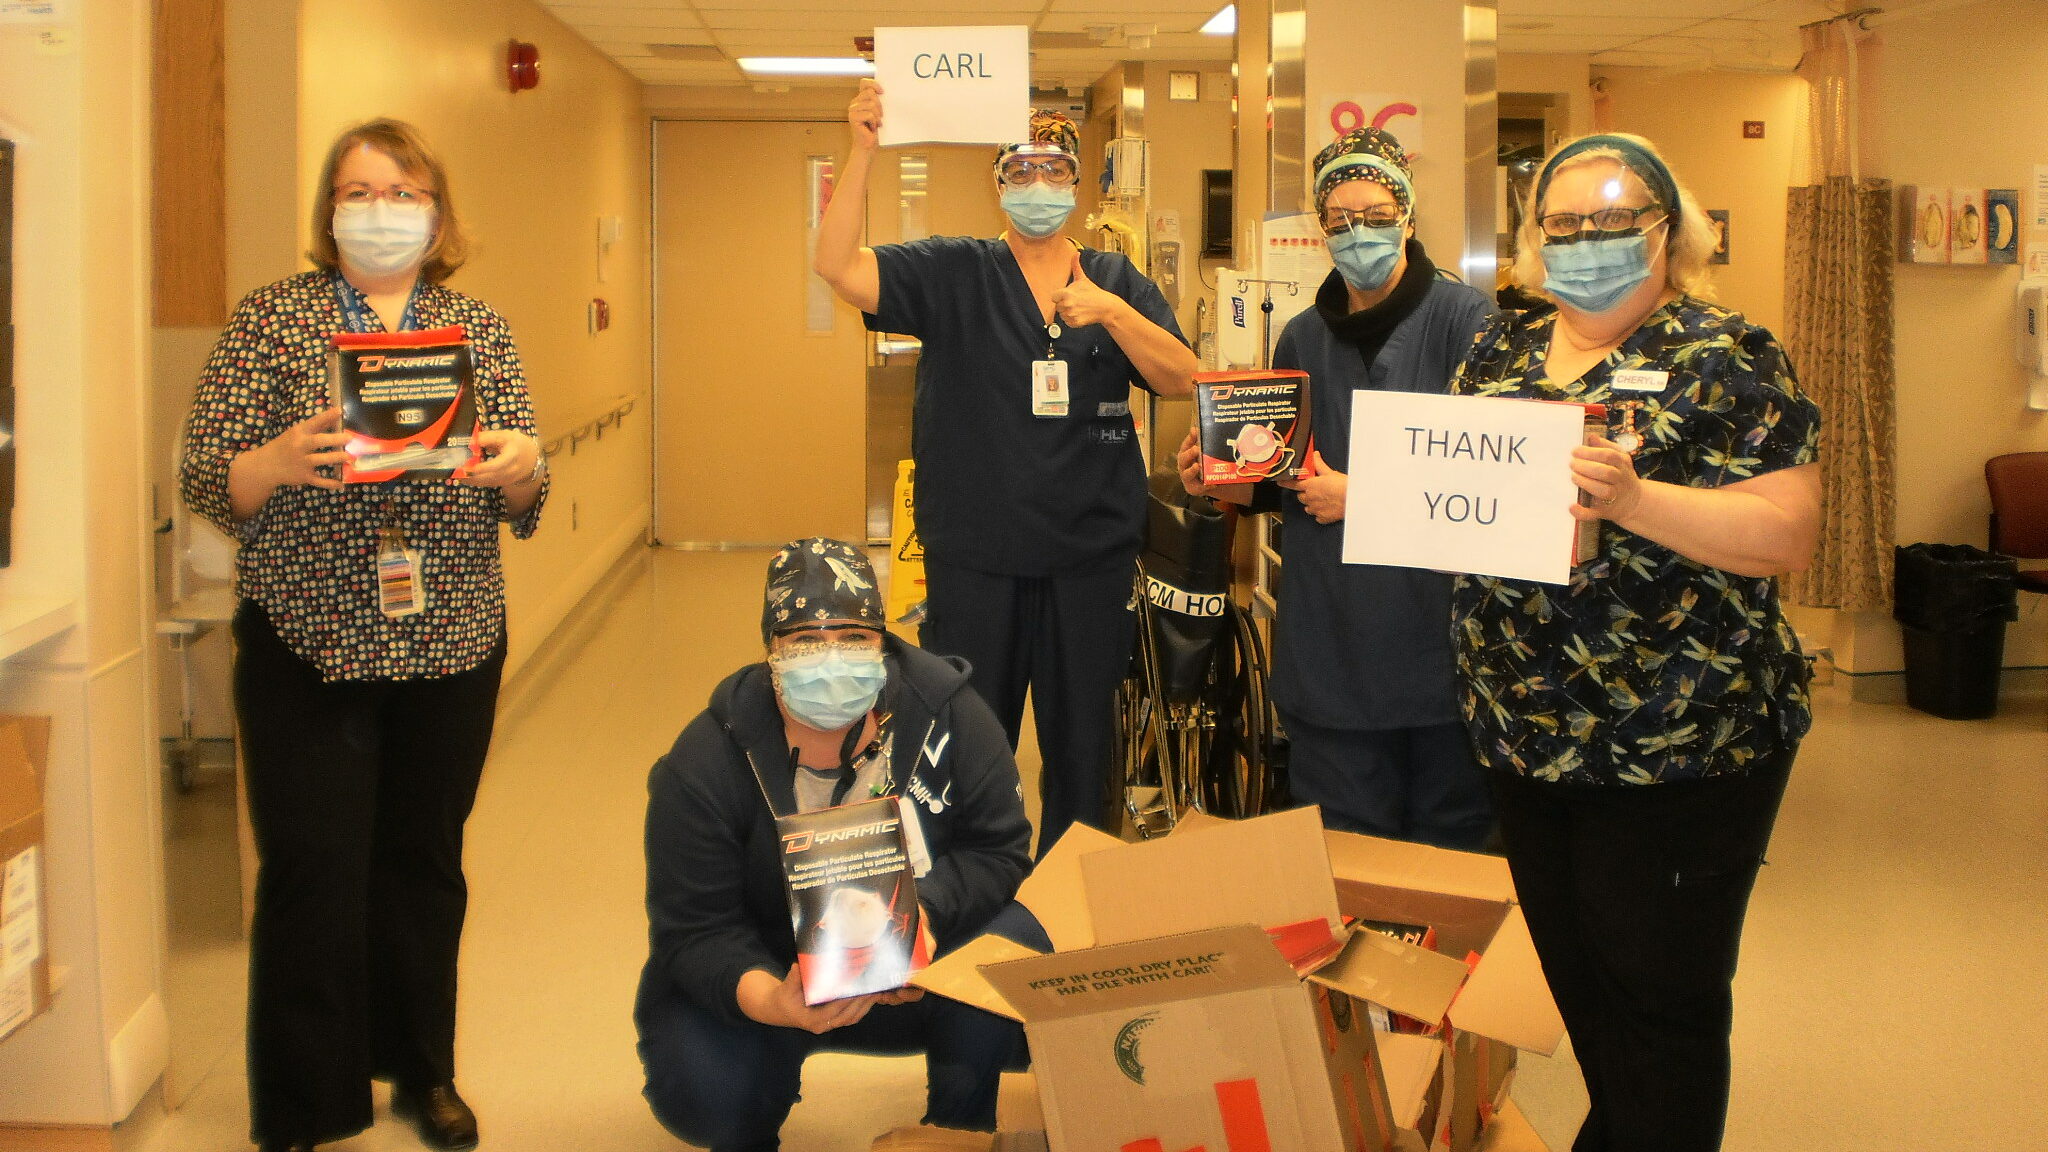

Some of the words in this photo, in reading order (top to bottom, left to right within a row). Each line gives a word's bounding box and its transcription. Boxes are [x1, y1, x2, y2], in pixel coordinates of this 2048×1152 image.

[913, 53, 992, 79] CARL
[1234, 298, 1244, 326] Purell
[1616, 375, 1656, 386] CHERYL
[399, 412, 421, 422] N95
[447, 437, 457, 447] 20
[1405, 427, 1527, 465] THANK
[1289, 468, 1294, 476] 5
[1424, 491, 1498, 525] YOU
[1186, 595, 1222, 615] HO
[788, 869, 825, 882] Respirateur
[848, 863, 863, 872] pour
[864, 860, 874, 868] les
[875, 854, 906, 867] particules
[794, 858, 829, 872] Disposable
[829, 853, 864, 866] Particulate
[864, 847, 897, 858] Respirator
[792, 879, 826, 891] Respirador
[827, 876, 836, 884] de
[869, 864, 905, 876] Desechable
[1028, 977, 1066, 990] KEEP
[1069, 973, 1089, 984] IN
[1092, 966, 1138, 980] COOL
[1139, 960, 1173, 973] DRY
[1124, 972, 1170, 985] WITH
